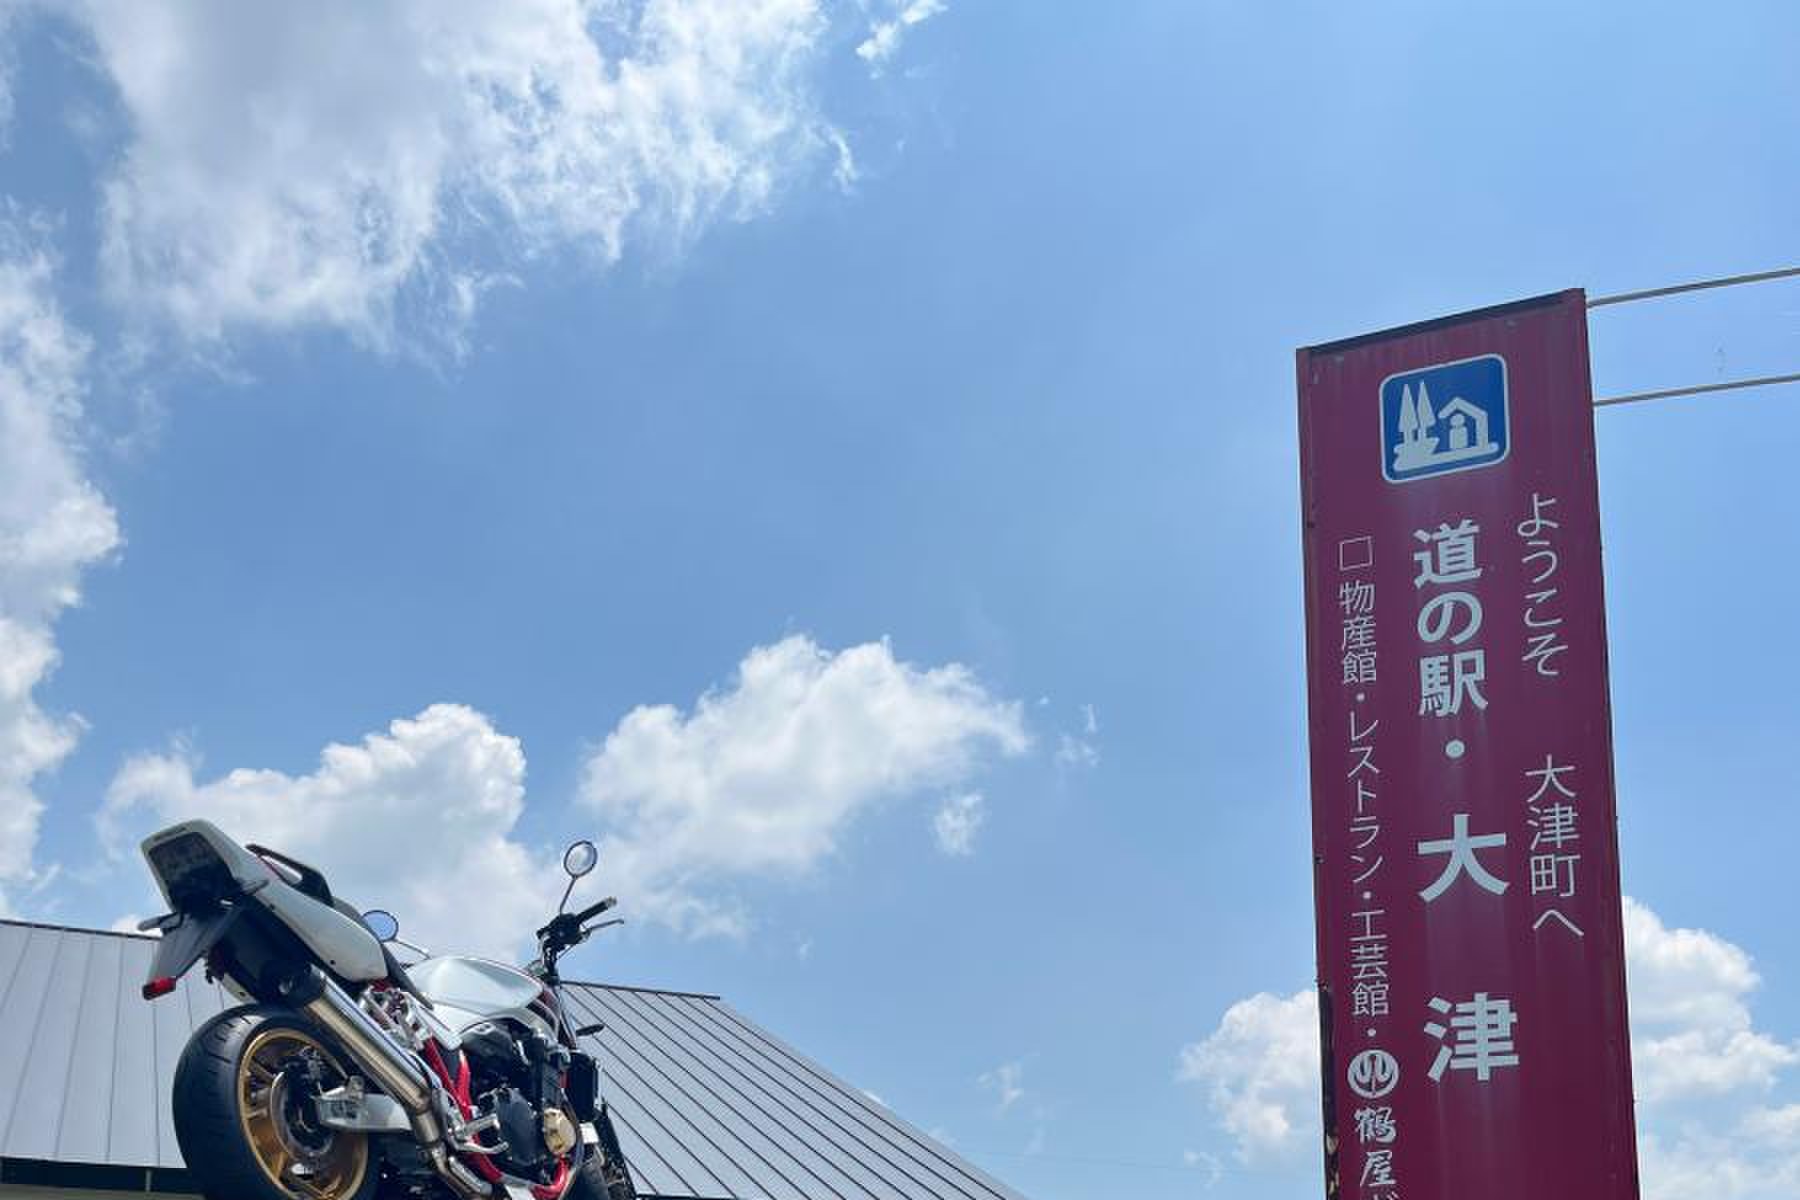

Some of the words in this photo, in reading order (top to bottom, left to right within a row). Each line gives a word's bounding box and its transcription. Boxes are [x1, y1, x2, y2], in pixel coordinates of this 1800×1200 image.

[1515, 492, 1570, 677] ようこそ
[1524, 754, 1585, 937] 大津町へ
